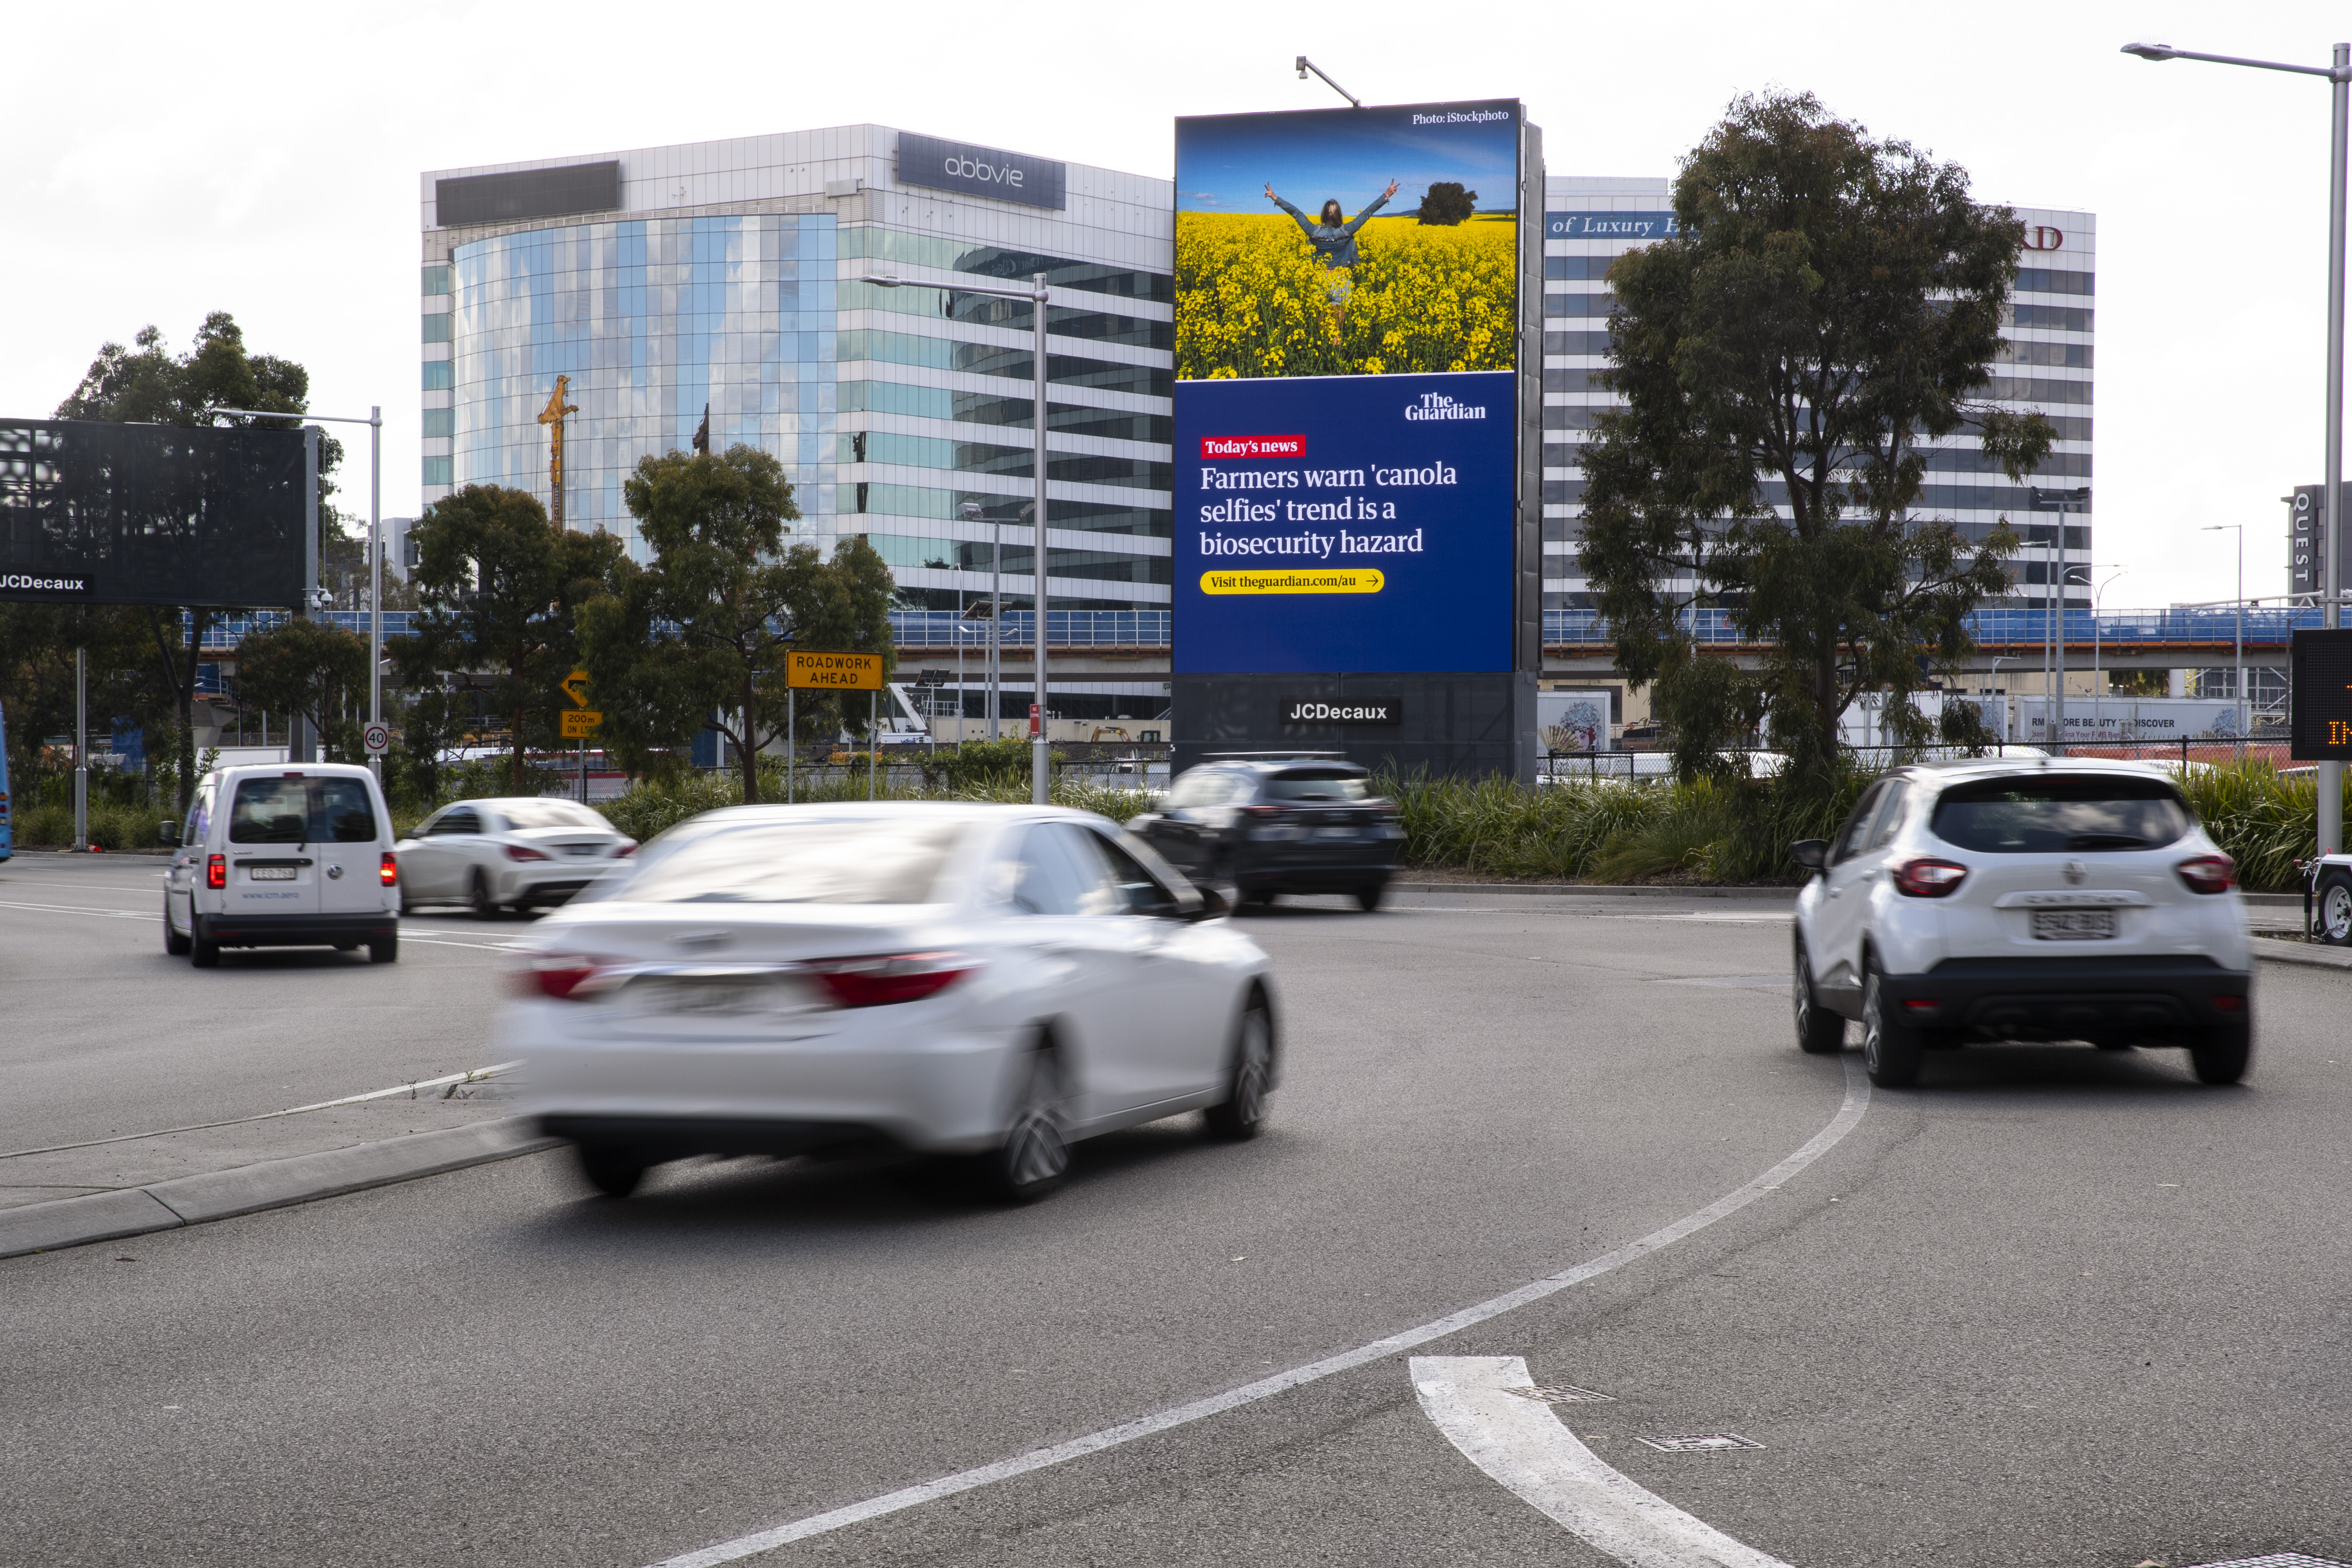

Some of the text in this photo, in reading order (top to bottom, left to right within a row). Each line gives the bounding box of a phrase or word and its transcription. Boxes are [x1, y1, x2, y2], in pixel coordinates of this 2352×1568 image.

[1412, 110, 1509, 125] Photo: iStockphoto
[945, 154, 1023, 188] abbvie
[1552, 216, 1577, 233] of
[1582, 217, 1654, 237] Luxury
[1421, 392, 1453, 408] The
[1405, 403, 1486, 421] Guardian
[1205, 439, 1298, 456] Today's news
[1200, 460, 1457, 490] Farmers warn 'canola
[1200, 496, 1397, 523] selfies' trend is a
[1199, 528, 1423, 559] biosecurity hazard
[2294, 493, 2310, 582] QUEST
[0, 574, 84, 590] JCDecaux
[1211, 574, 1357, 589] Visit theguardian.com/au
[796, 656, 872, 669] ROADWORK
[810, 672, 858, 685] AHEAD
[1290, 703, 1387, 719] JCDecaux
[567, 725, 577, 734] ON
[2063, 717, 2081, 727] ORE
[368, 732, 384, 743] 40
